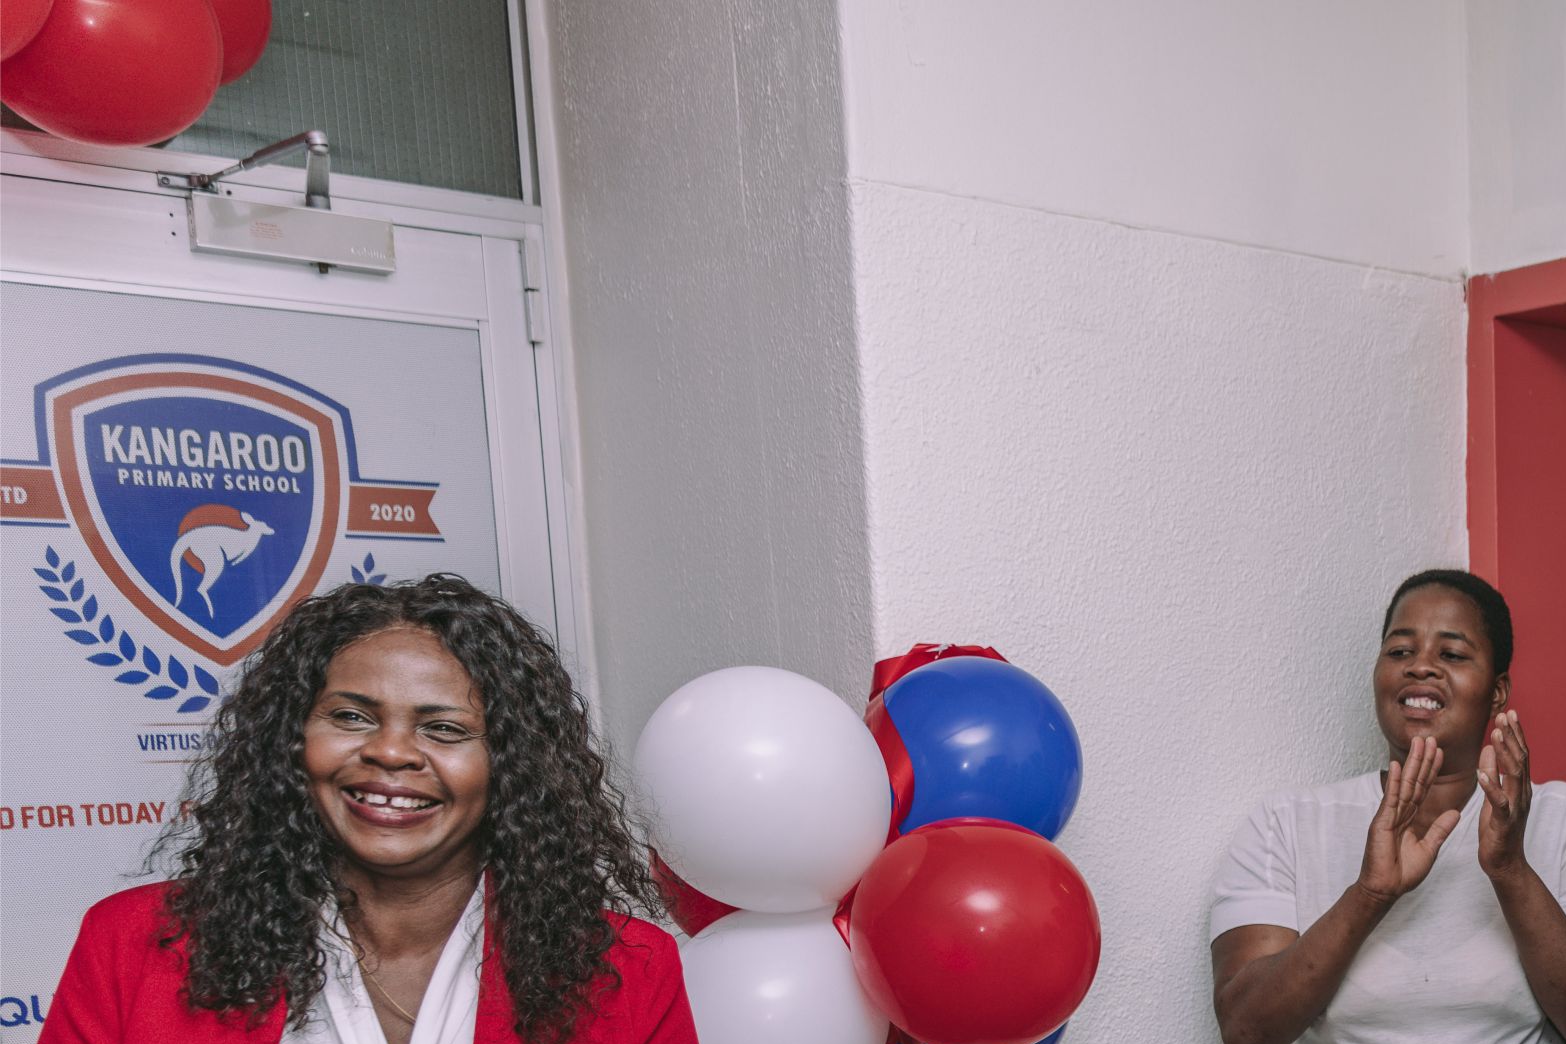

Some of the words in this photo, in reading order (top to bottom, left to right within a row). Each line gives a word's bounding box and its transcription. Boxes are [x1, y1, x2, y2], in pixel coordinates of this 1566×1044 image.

[101, 423, 306, 474] KANGAROO
[117, 468, 215, 490] PRIMARY
[223, 474, 301, 494] SCHOOL
[369, 503, 416, 522] 2020
[138, 733, 202, 751] VIRTUS
[20, 805, 75, 829] FOR
